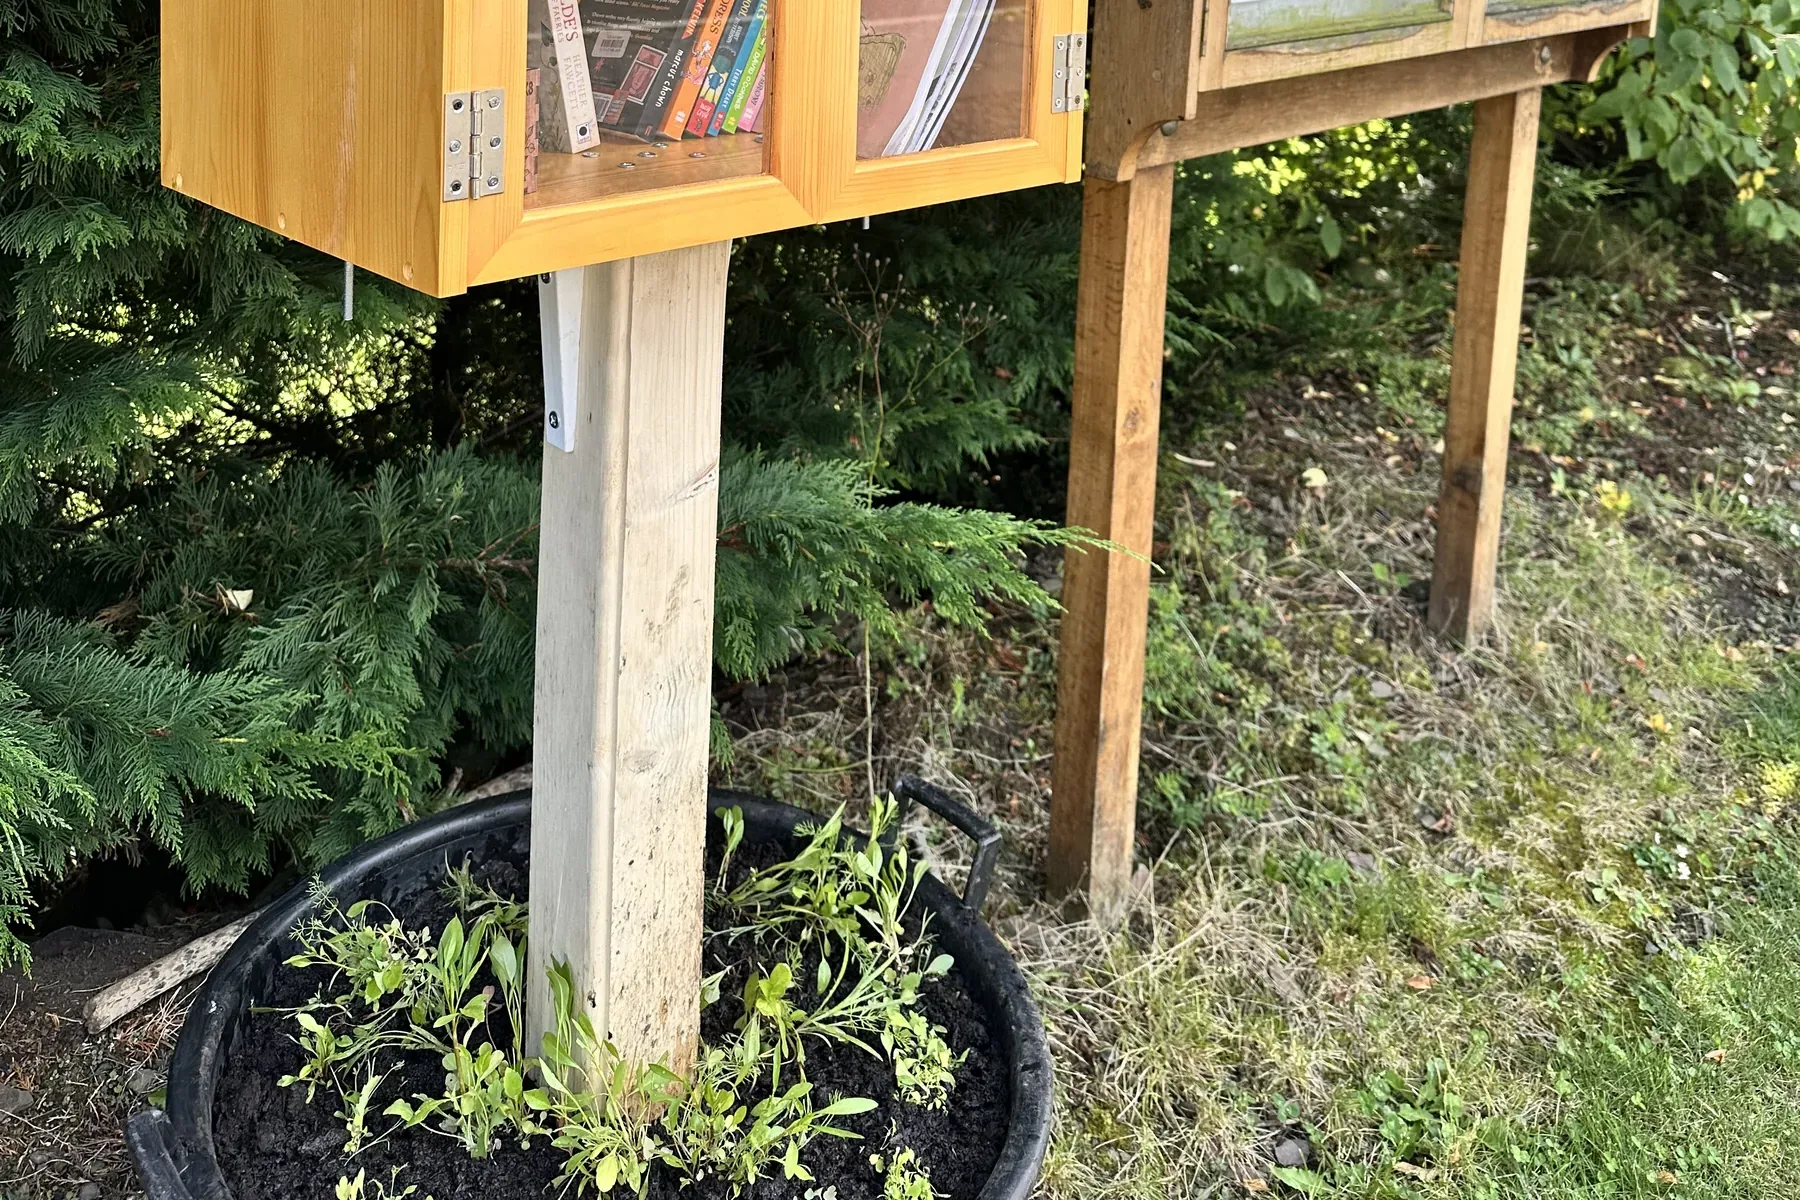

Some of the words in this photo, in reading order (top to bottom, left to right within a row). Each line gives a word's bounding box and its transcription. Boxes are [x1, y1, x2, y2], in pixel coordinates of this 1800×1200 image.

[552, 5, 565, 44] FAERIES
[685, 2, 704, 36] KELVIN
[573, 53, 588, 107] HEATHER
[666, 48, 684, 84] marcus
[732, 68, 742, 88] TERRY
[748, 51, 761, 75] DAVID
[563, 55, 579, 110] FAWCETT
[655, 83, 675, 108] chown
[721, 87, 735, 109] DEARY
